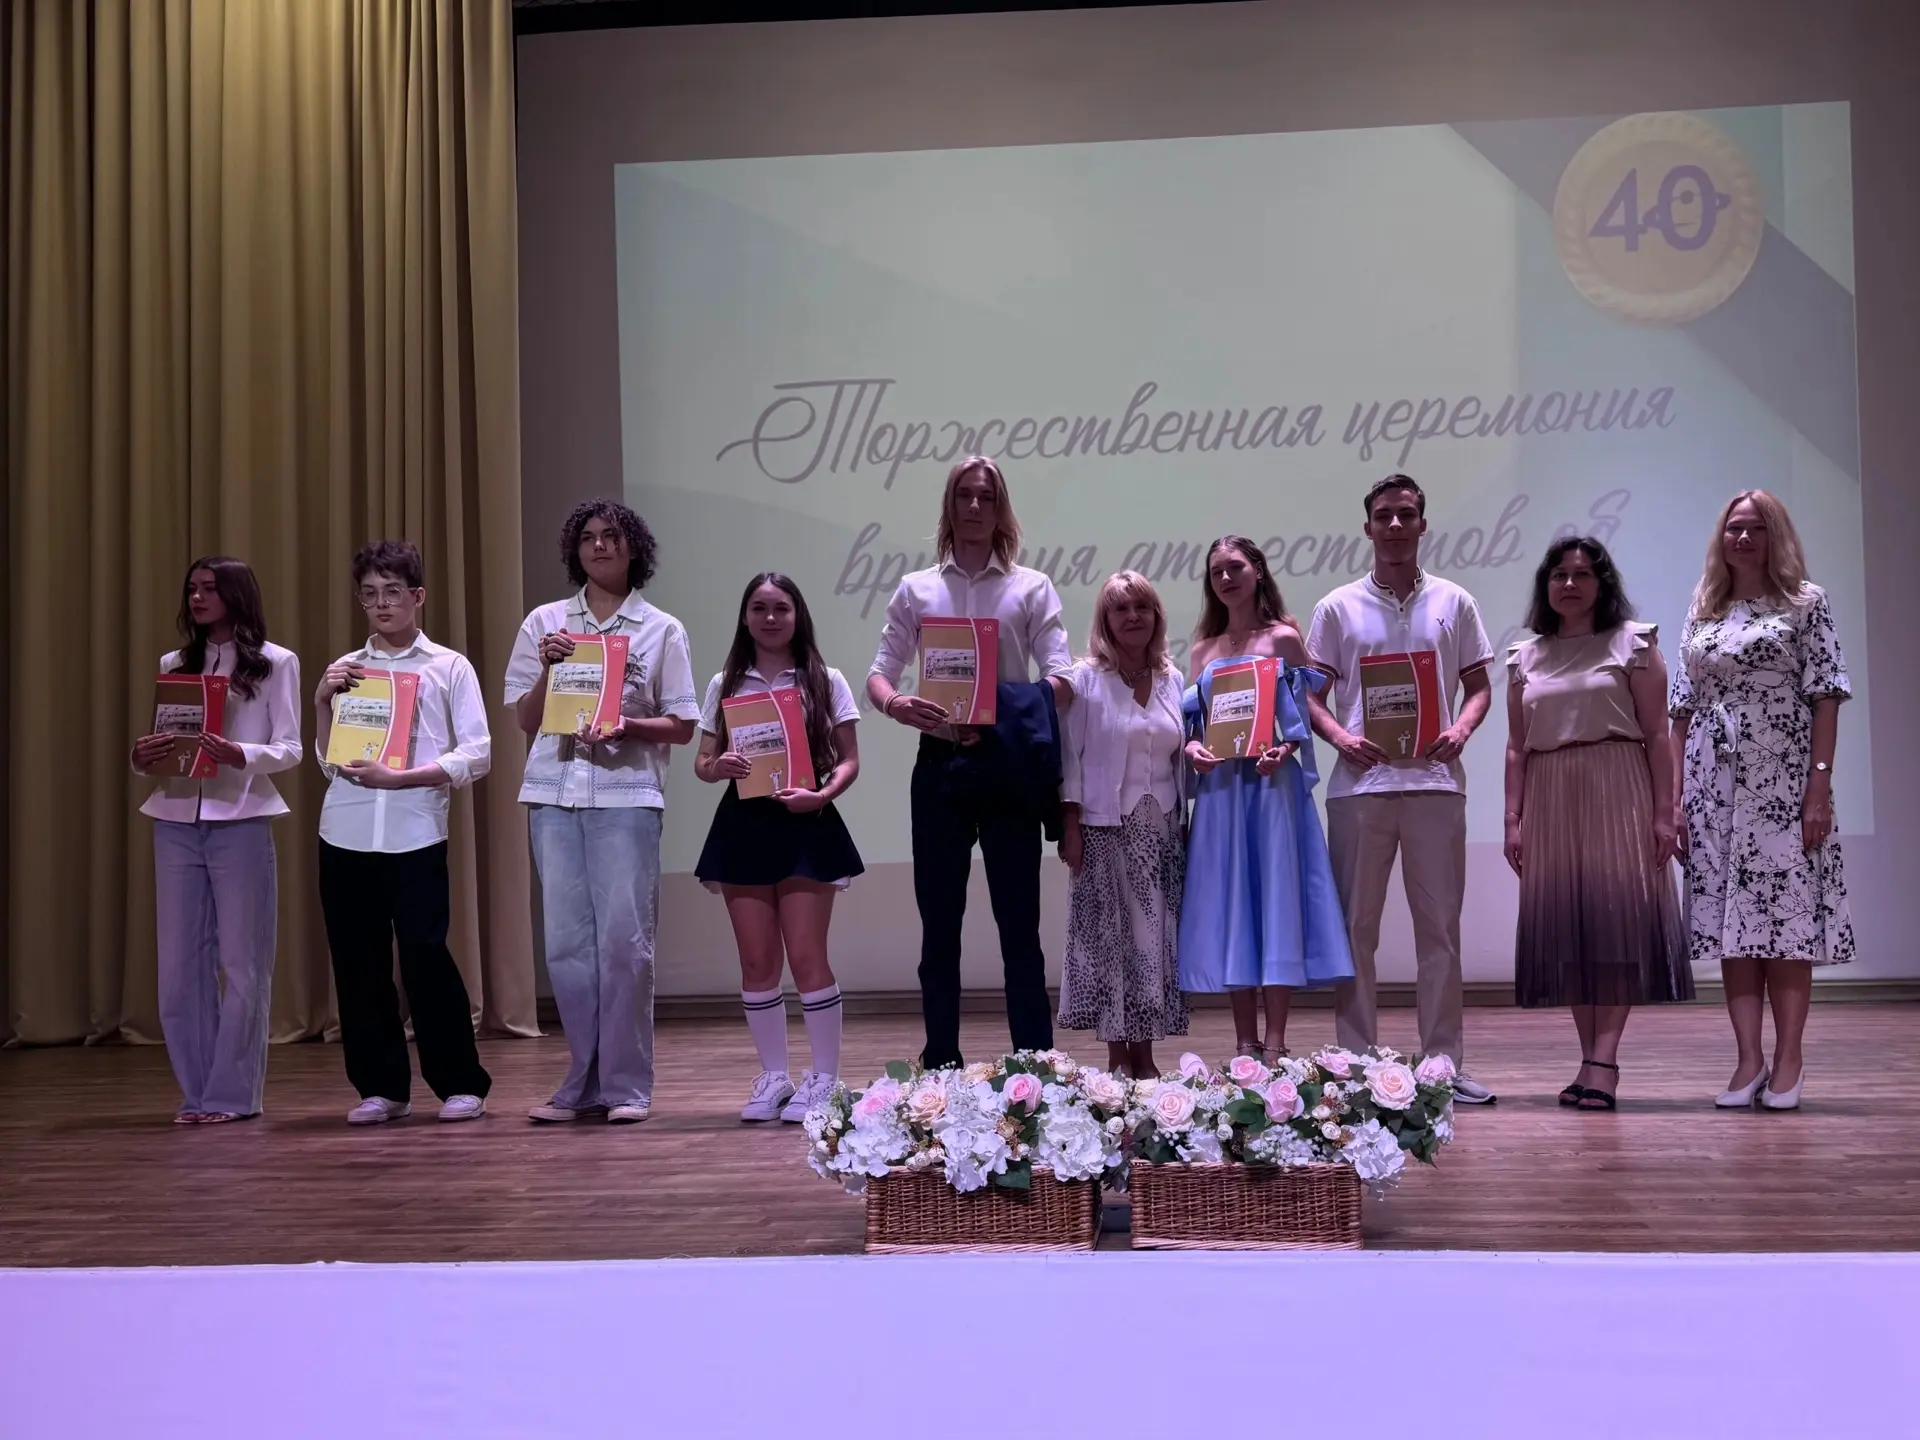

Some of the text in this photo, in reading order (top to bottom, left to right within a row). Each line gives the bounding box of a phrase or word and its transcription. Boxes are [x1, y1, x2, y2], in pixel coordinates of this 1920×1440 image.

[1588, 163, 1732, 253] 40
[716, 377, 1675, 491] Торжественная церемония
